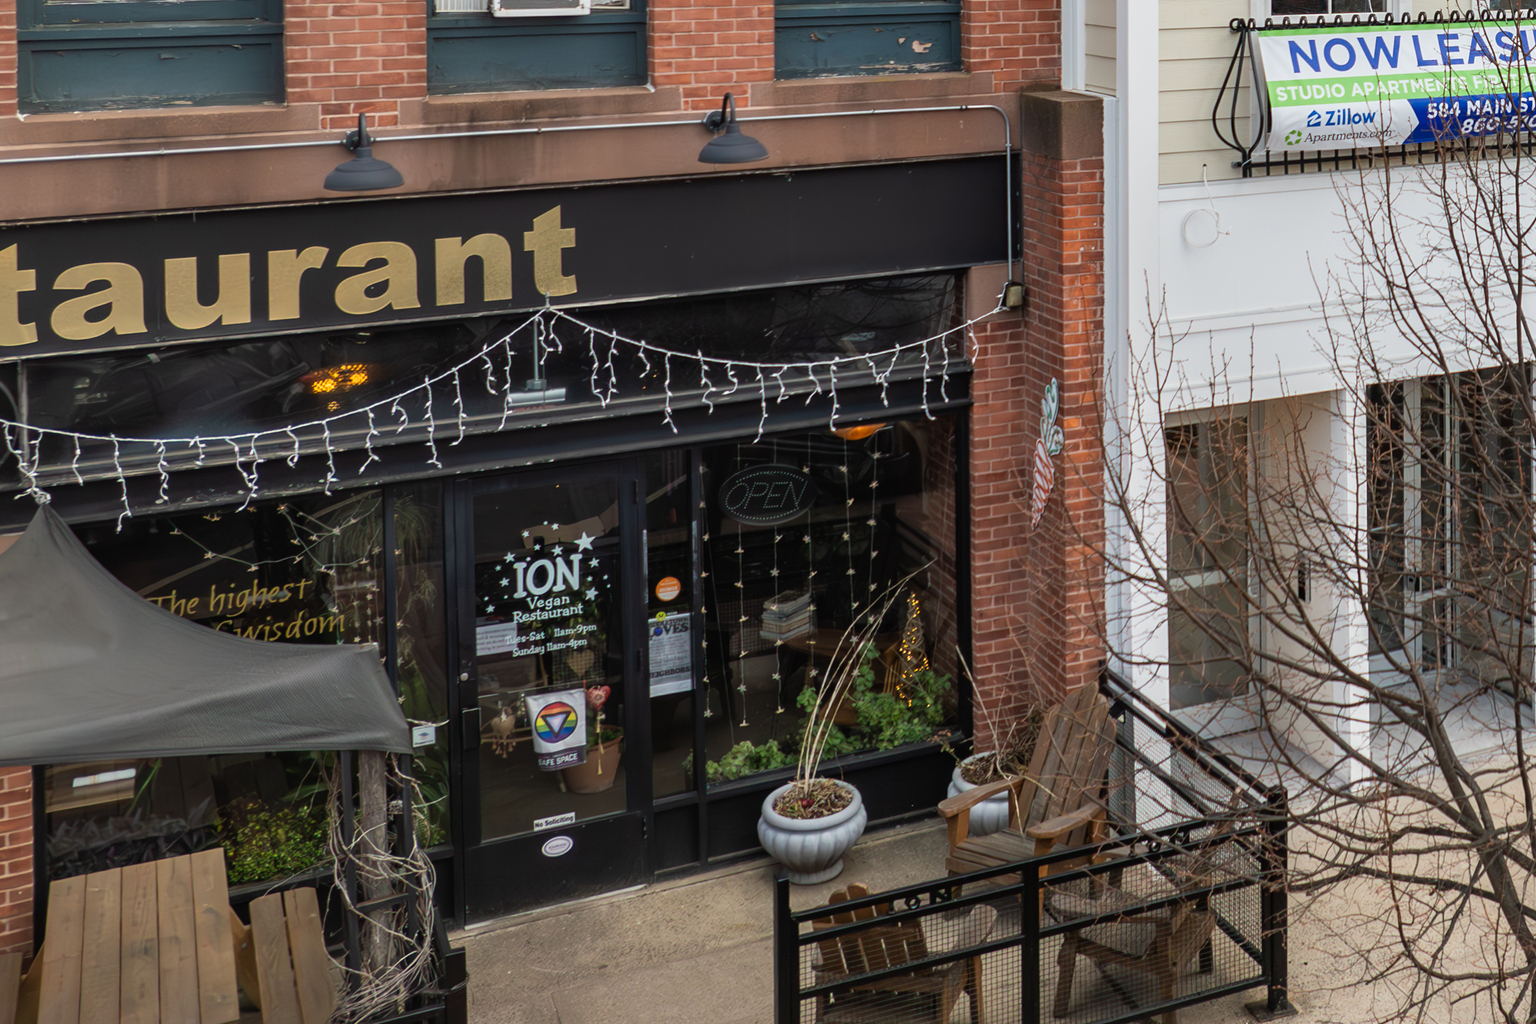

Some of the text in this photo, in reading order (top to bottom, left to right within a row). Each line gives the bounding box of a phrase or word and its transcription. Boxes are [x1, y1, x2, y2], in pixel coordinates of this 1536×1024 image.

[1288, 35, 1402, 74] NOW
[1276, 82, 1346, 102] STUDIO
[1351, 74, 1468, 98] APARTMENTS
[1325, 108, 1377, 128] Zillow
[1427, 101, 1462, 120] 584
[1466, 98, 1513, 117] MAIN
[1303, 129, 1394, 145] Apartments.com
[724, 479, 809, 511] OPEN
[513, 553, 584, 600] ION
[147, 578, 313, 618] The highest
[526, 595, 571, 610] Vegan
[512, 603, 584, 624] Restaurant
[505, 630, 545, 646] Tues-Sat
[554, 622, 597, 638] 11am-9pm
[512, 640, 545, 658] Sunday
[547, 638, 588, 653] 11am-4pm
[537, 752, 578, 766] SAFE SPACE
[534, 814, 574, 829] No Soliciting
